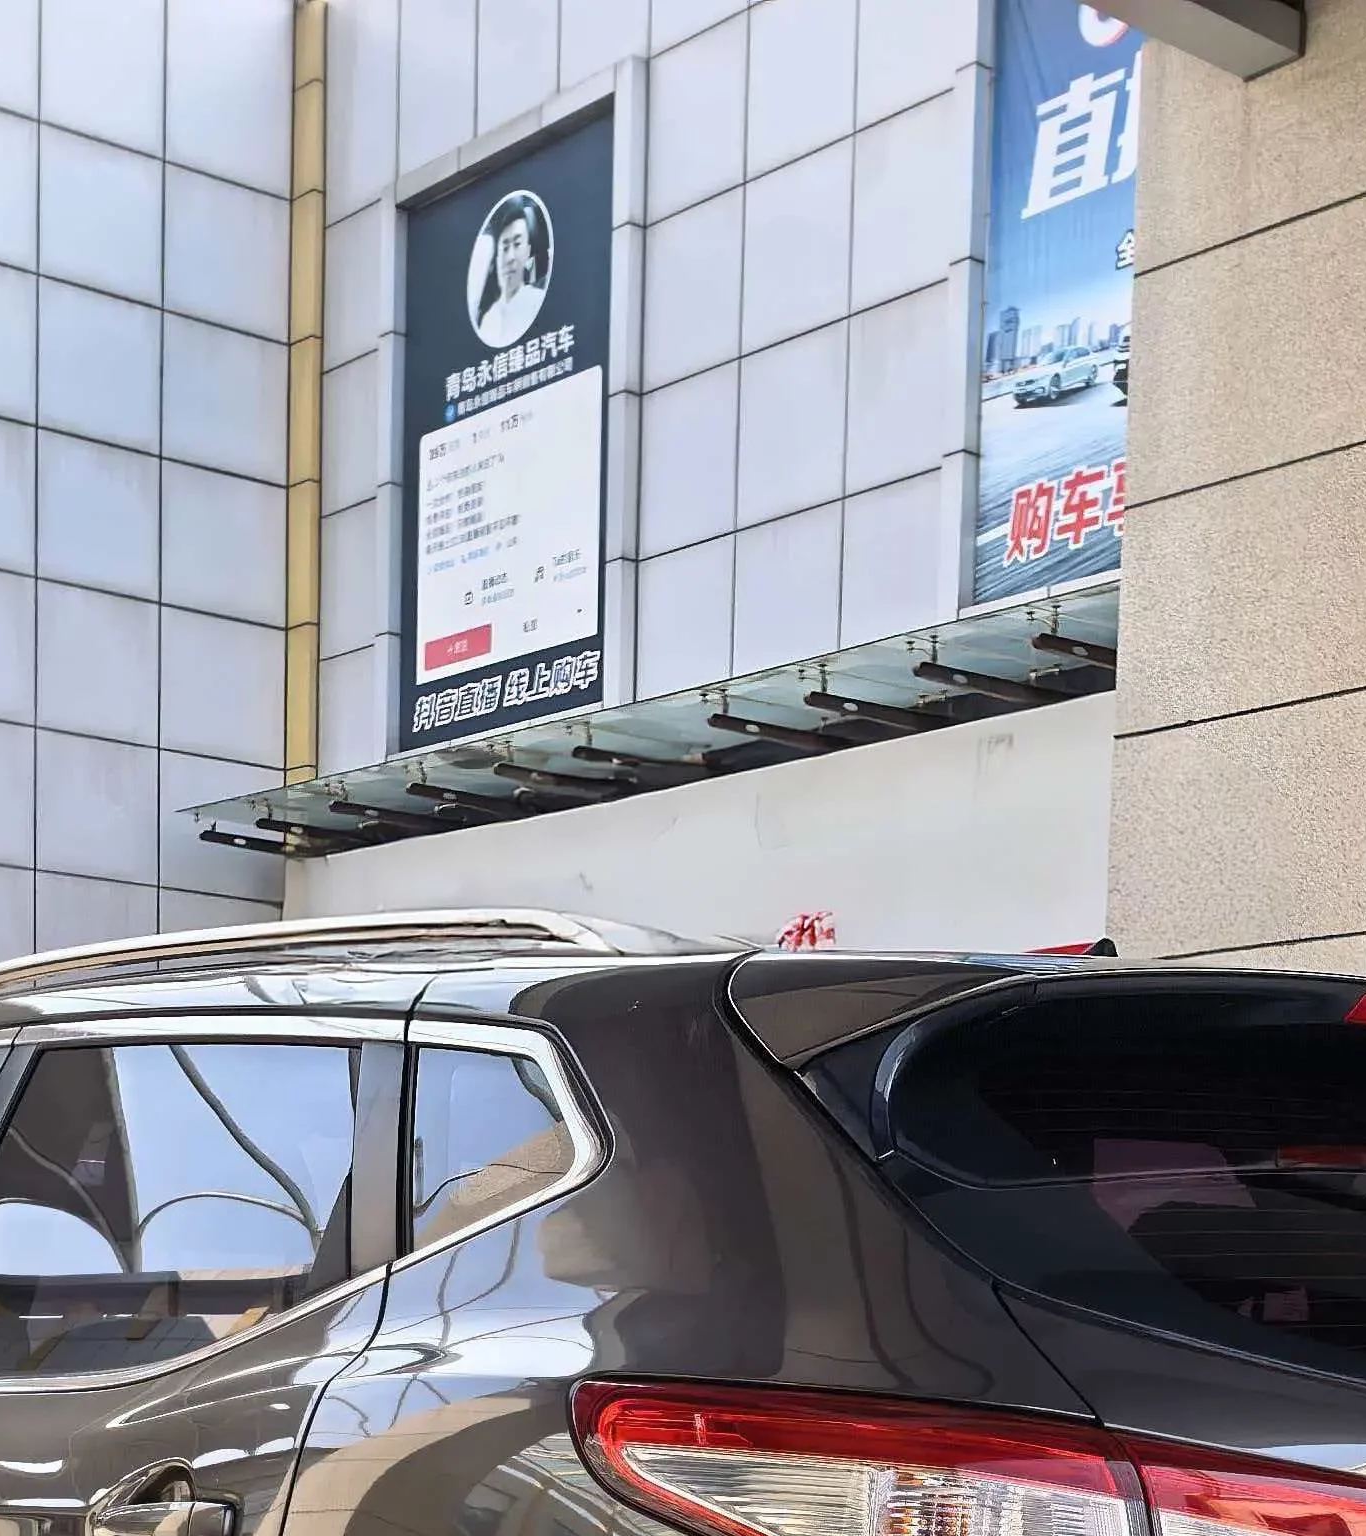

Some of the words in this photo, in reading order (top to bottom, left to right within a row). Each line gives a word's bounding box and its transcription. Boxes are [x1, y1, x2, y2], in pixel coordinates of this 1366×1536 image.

[412, 675, 502, 732] 抖音直播
[503, 651, 601, 707] 线上购车
